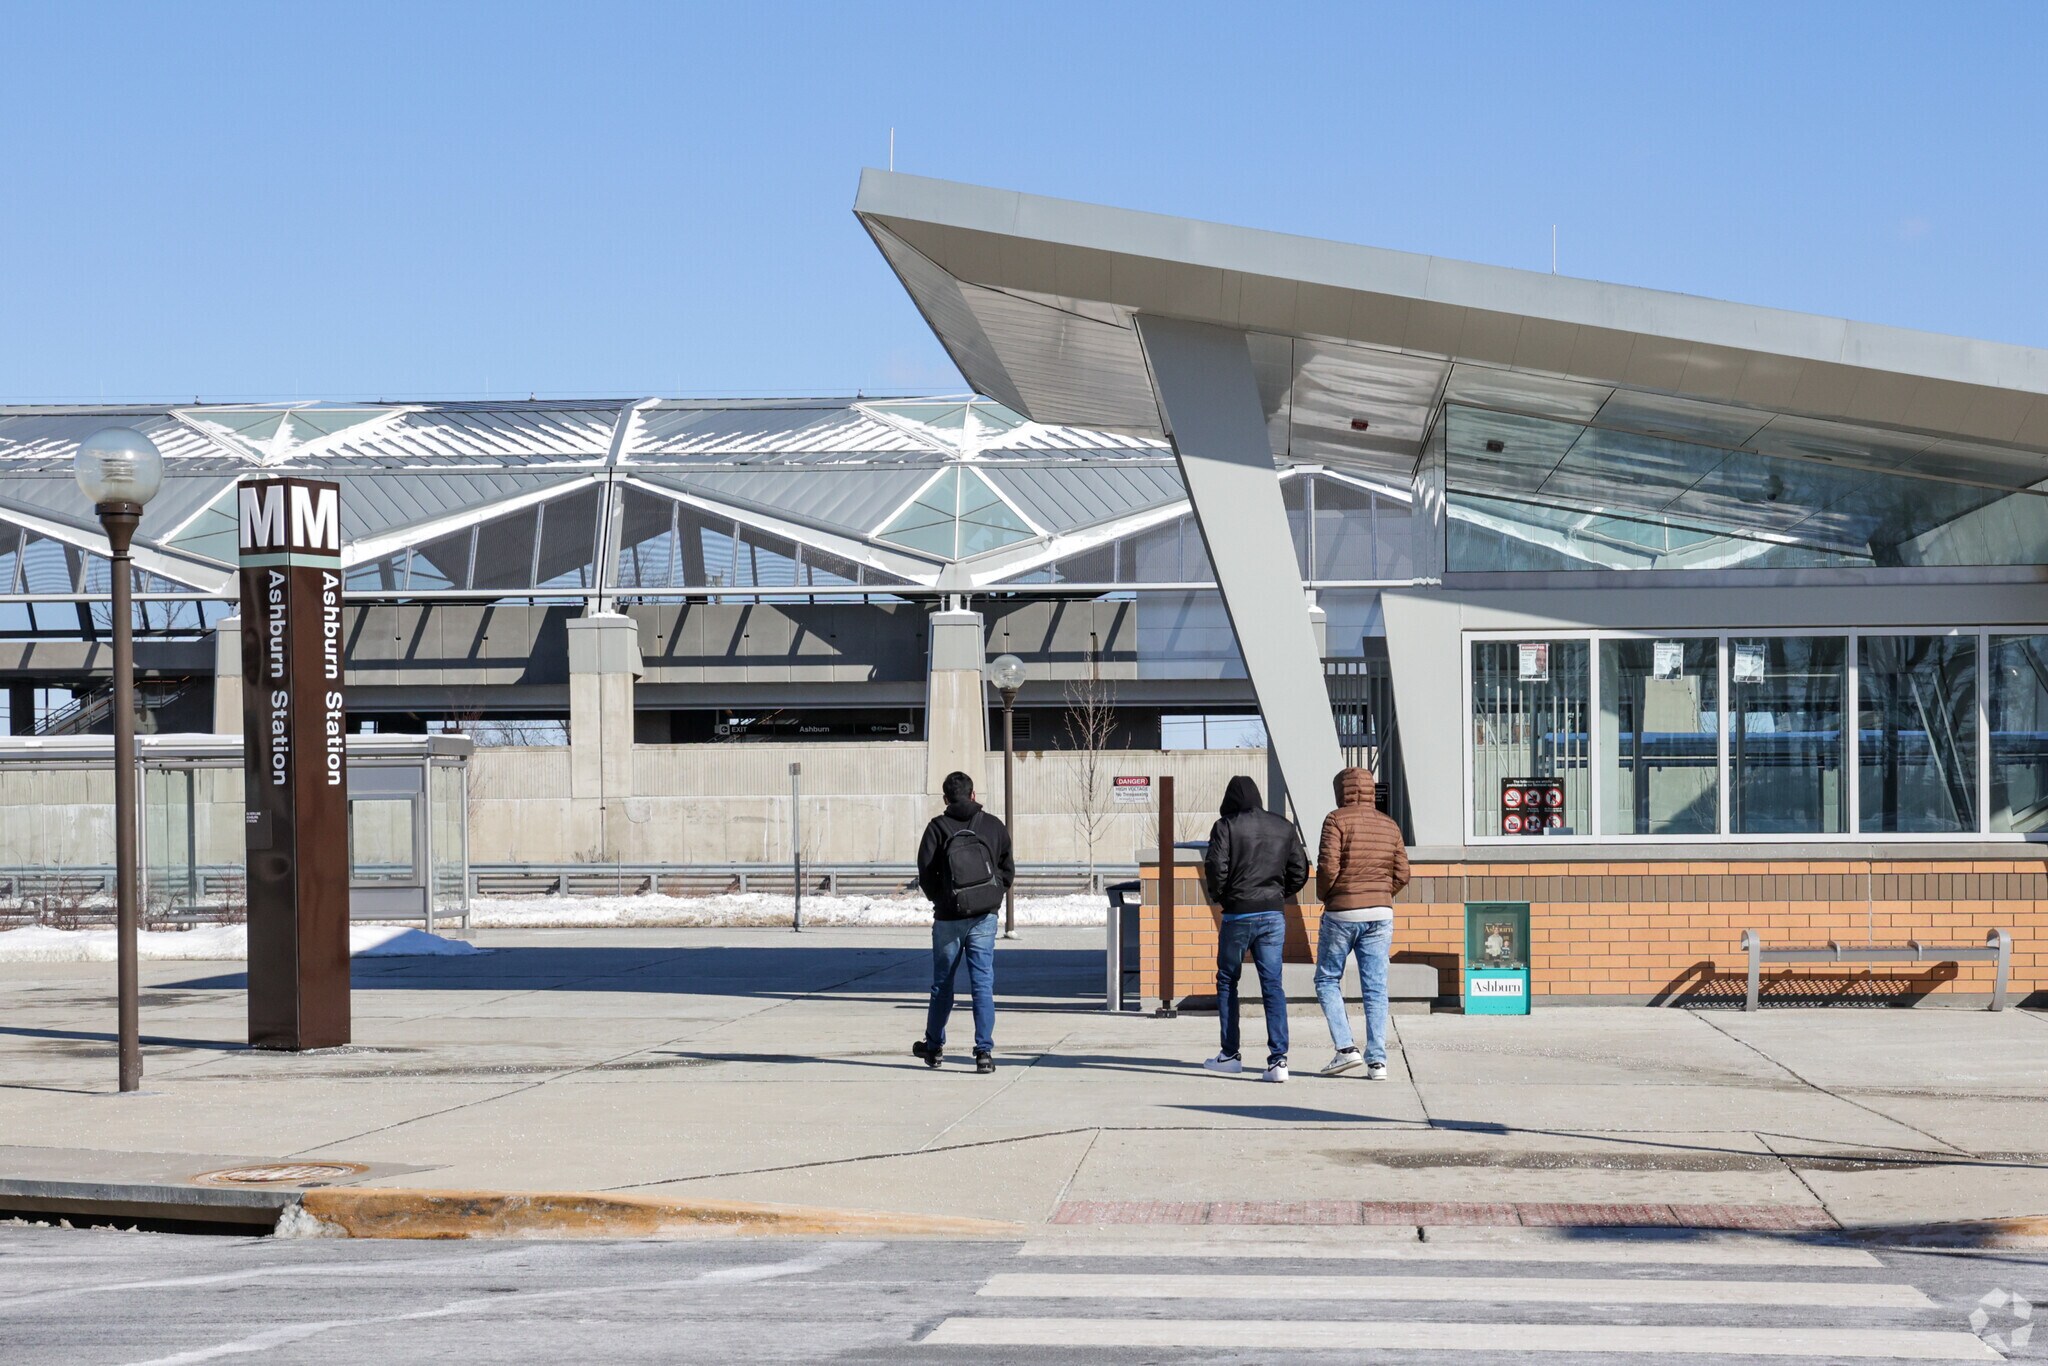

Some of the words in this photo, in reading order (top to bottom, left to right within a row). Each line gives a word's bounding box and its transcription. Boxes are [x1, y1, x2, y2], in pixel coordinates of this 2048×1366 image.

[239, 485, 285, 549] M
[290, 485, 339, 550] M
[268, 570, 286, 679] Ashburn
[322, 571, 341, 680] Ashburn
[271, 690, 289, 786] Station
[325, 691, 344, 786] Station
[1473, 980, 1521, 992] Ashburn
